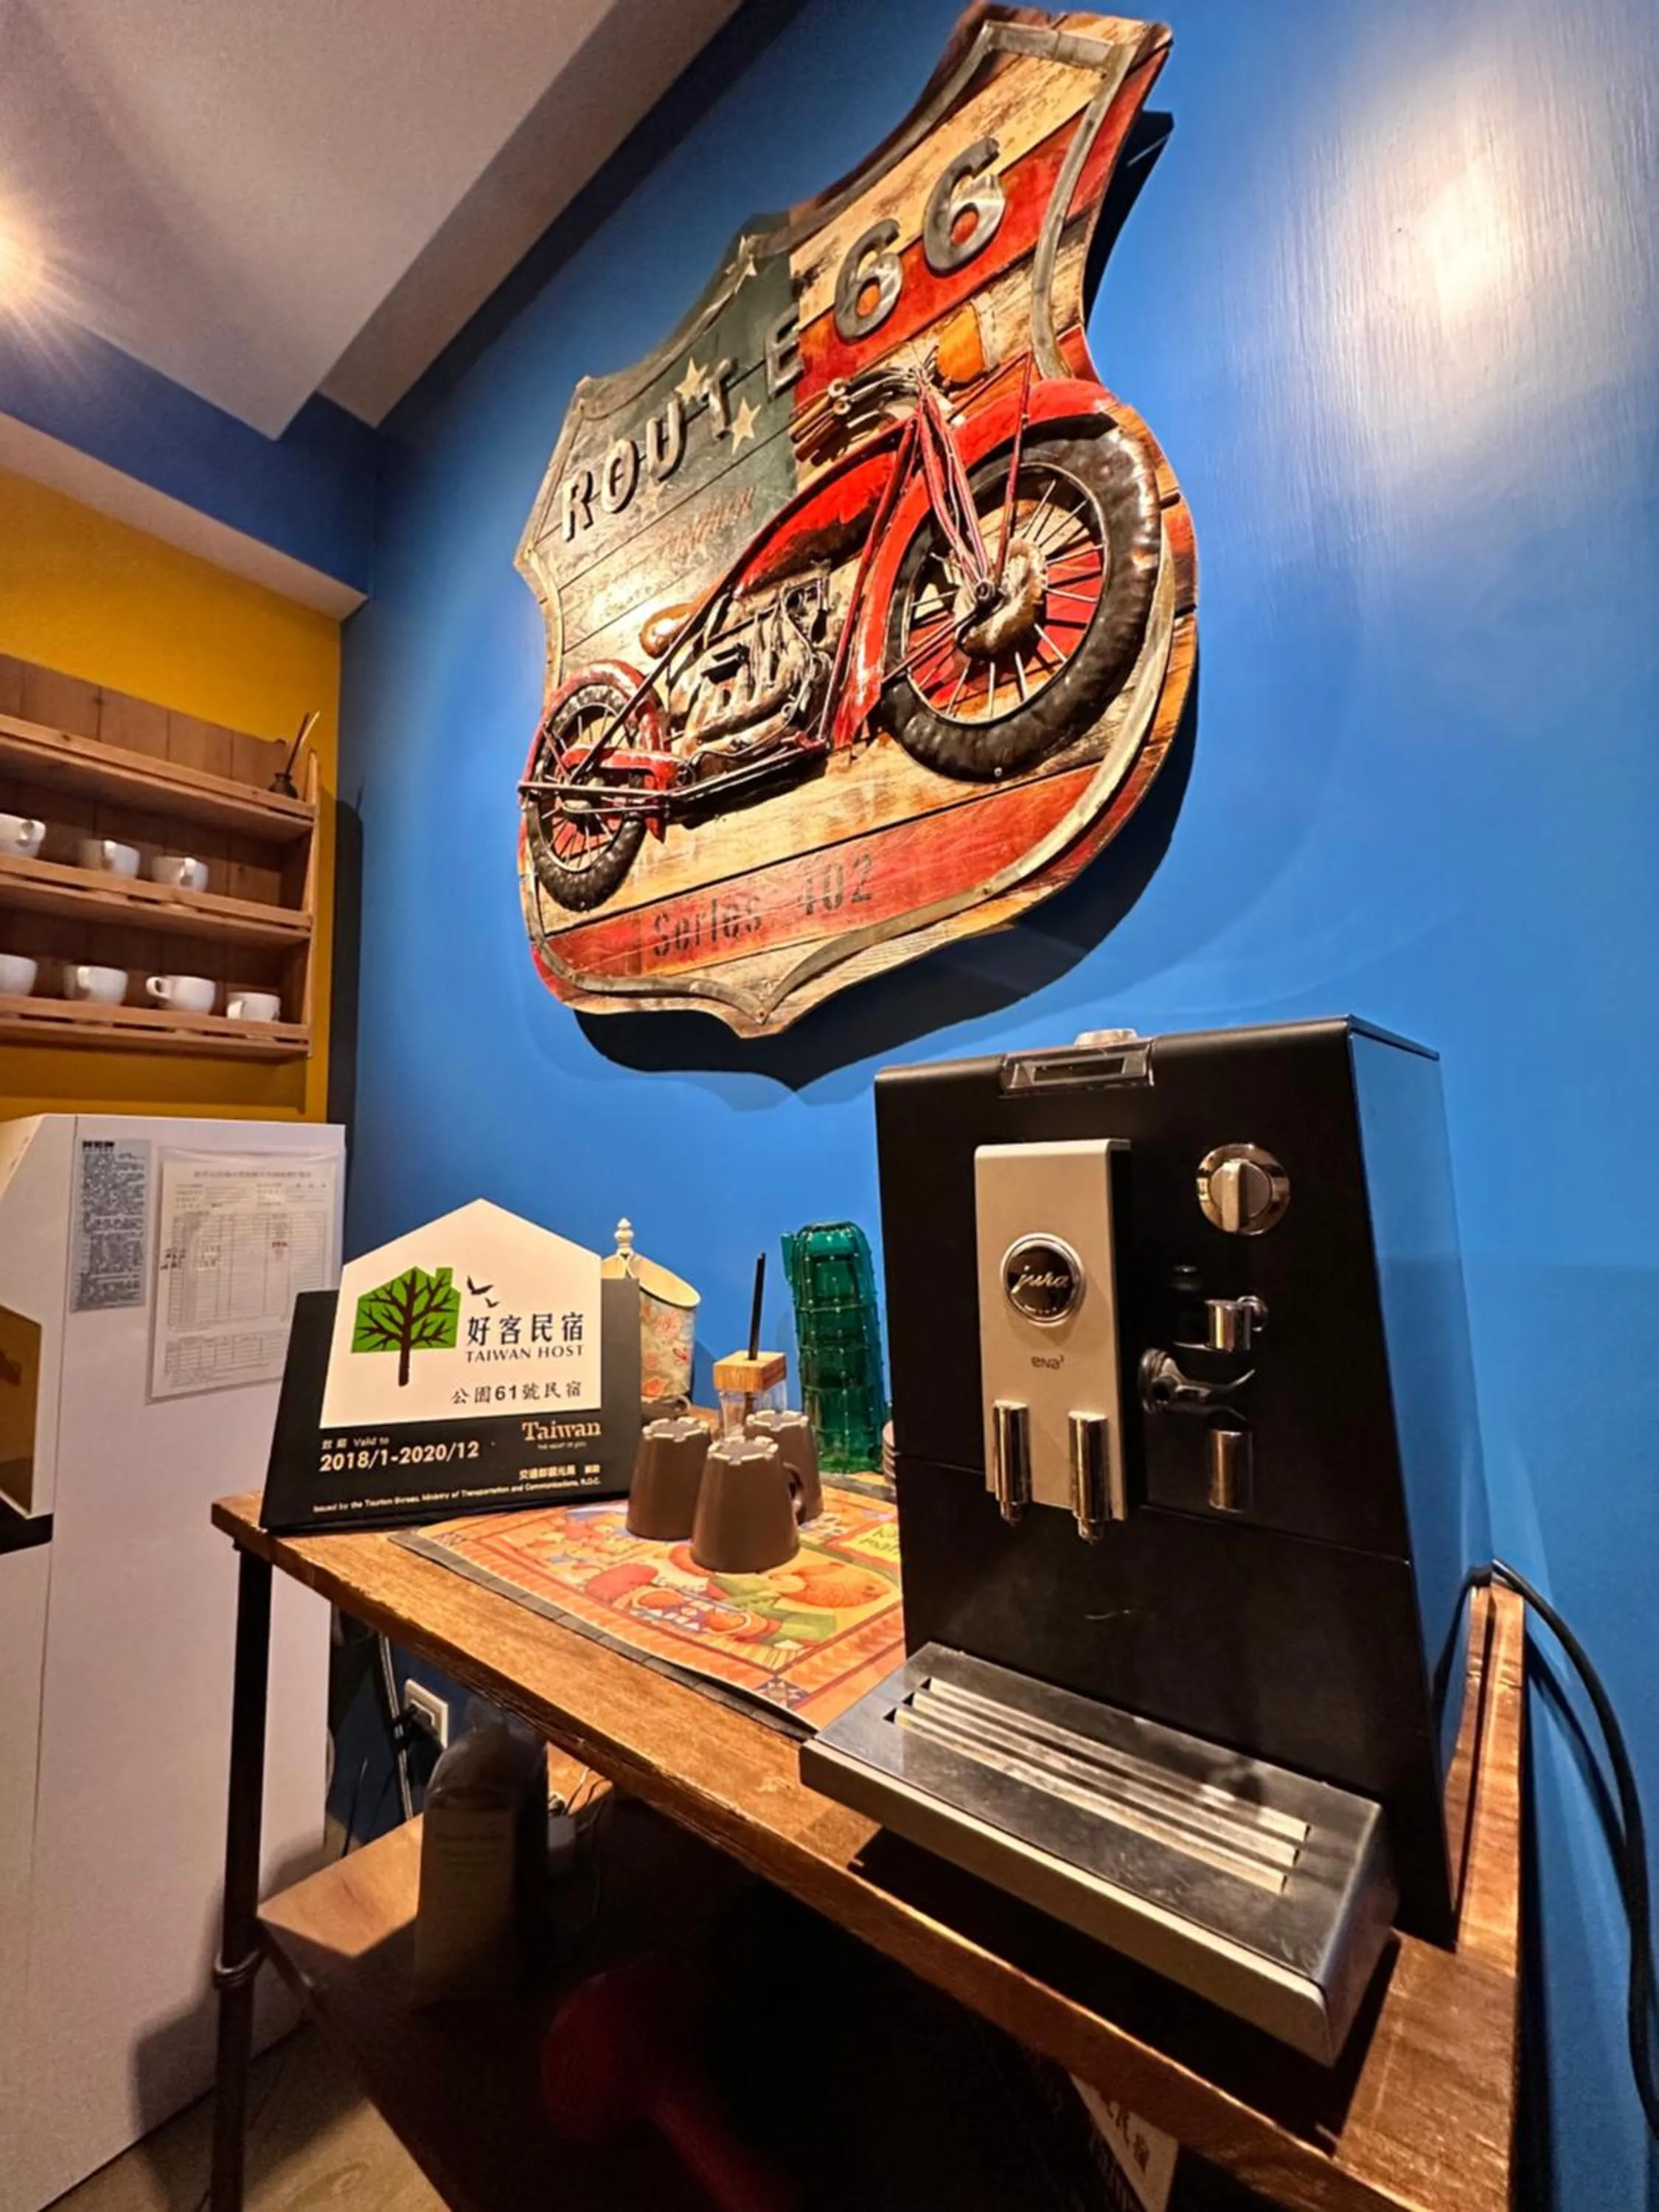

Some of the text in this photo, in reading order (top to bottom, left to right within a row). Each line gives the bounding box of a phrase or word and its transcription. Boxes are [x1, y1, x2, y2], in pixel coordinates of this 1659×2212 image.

[834, 136, 1006, 341] 66
[561, 302, 806, 543] ROUTE
[467, 1311, 584, 1347] 好客民宿
[466, 1343, 584, 1364] TAIWAN HOST
[451, 1380, 582, 1405] 公園61號民宿
[521, 1420, 602, 1441] Taiwan
[319, 1440, 480, 1472] 2018/1-2020/12
